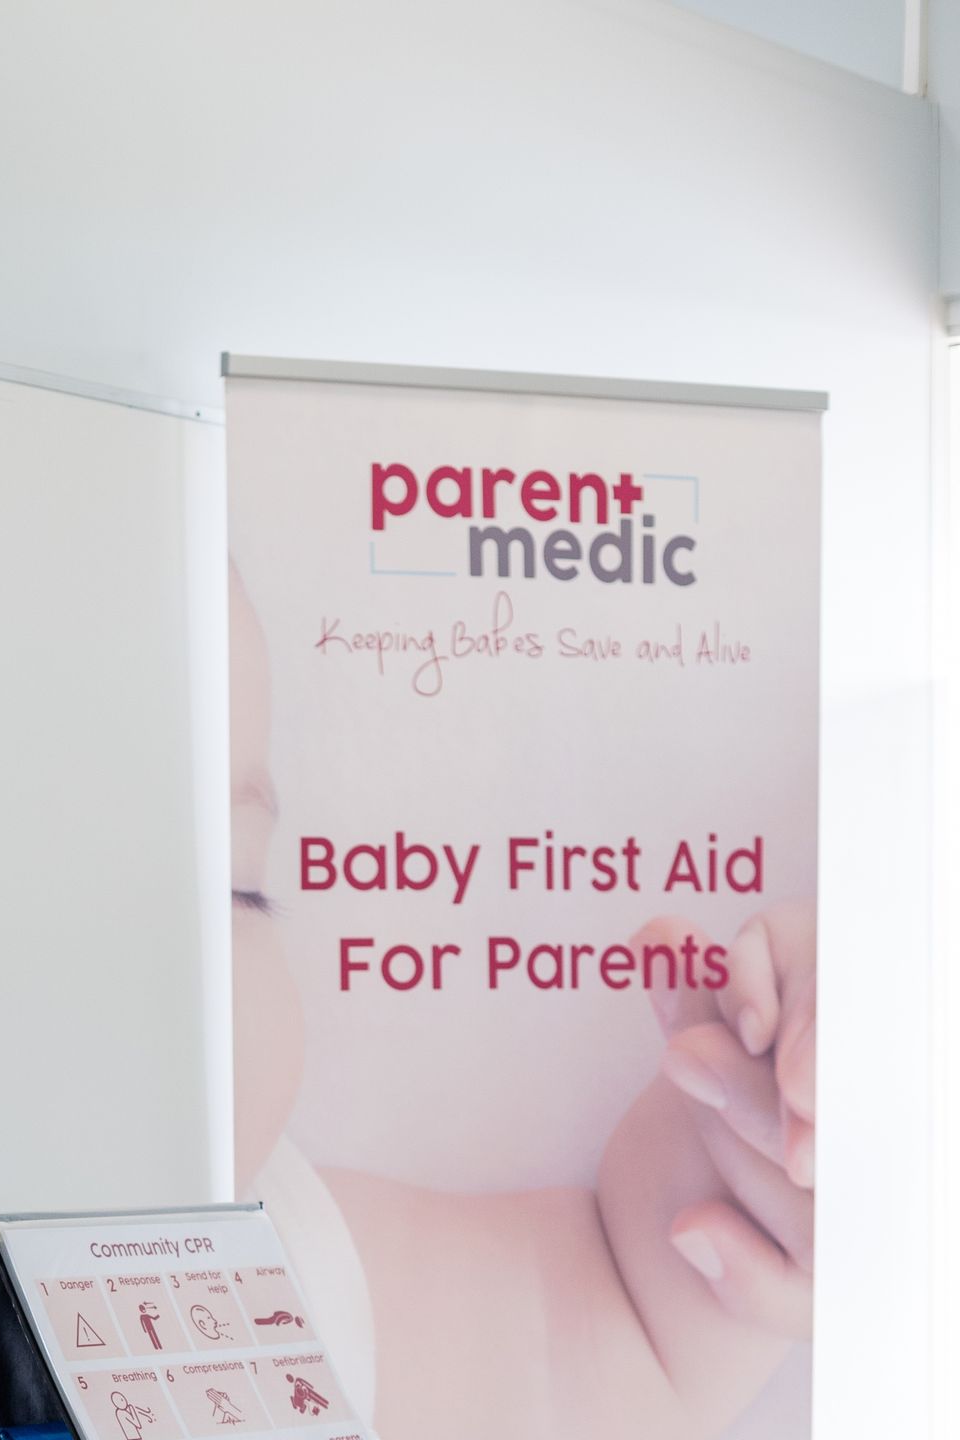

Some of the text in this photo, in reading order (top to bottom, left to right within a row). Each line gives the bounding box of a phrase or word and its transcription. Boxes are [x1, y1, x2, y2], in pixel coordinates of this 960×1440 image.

[468, 514, 697, 587] medic
[315, 591, 751, 696] Keeping Babes Save and Alive
[300, 830, 764, 904] Baby First Aid
[339, 934, 730, 992] For Parents
[90, 1238, 214, 1258] Community CPR
[106, 1276, 161, 1293] 2 Response
[170, 1270, 221, 1289] 3 Send for
[234, 1267, 286, 1284] 4 Airway
[40, 1280, 94, 1297] 1 Danger
[208, 1284, 228, 1295] Help
[166, 1361, 245, 1383] 6 Compressions
[249, 1354, 325, 1375] 7 Defibrillator
[77, 1370, 158, 1390] 5 Breathing
